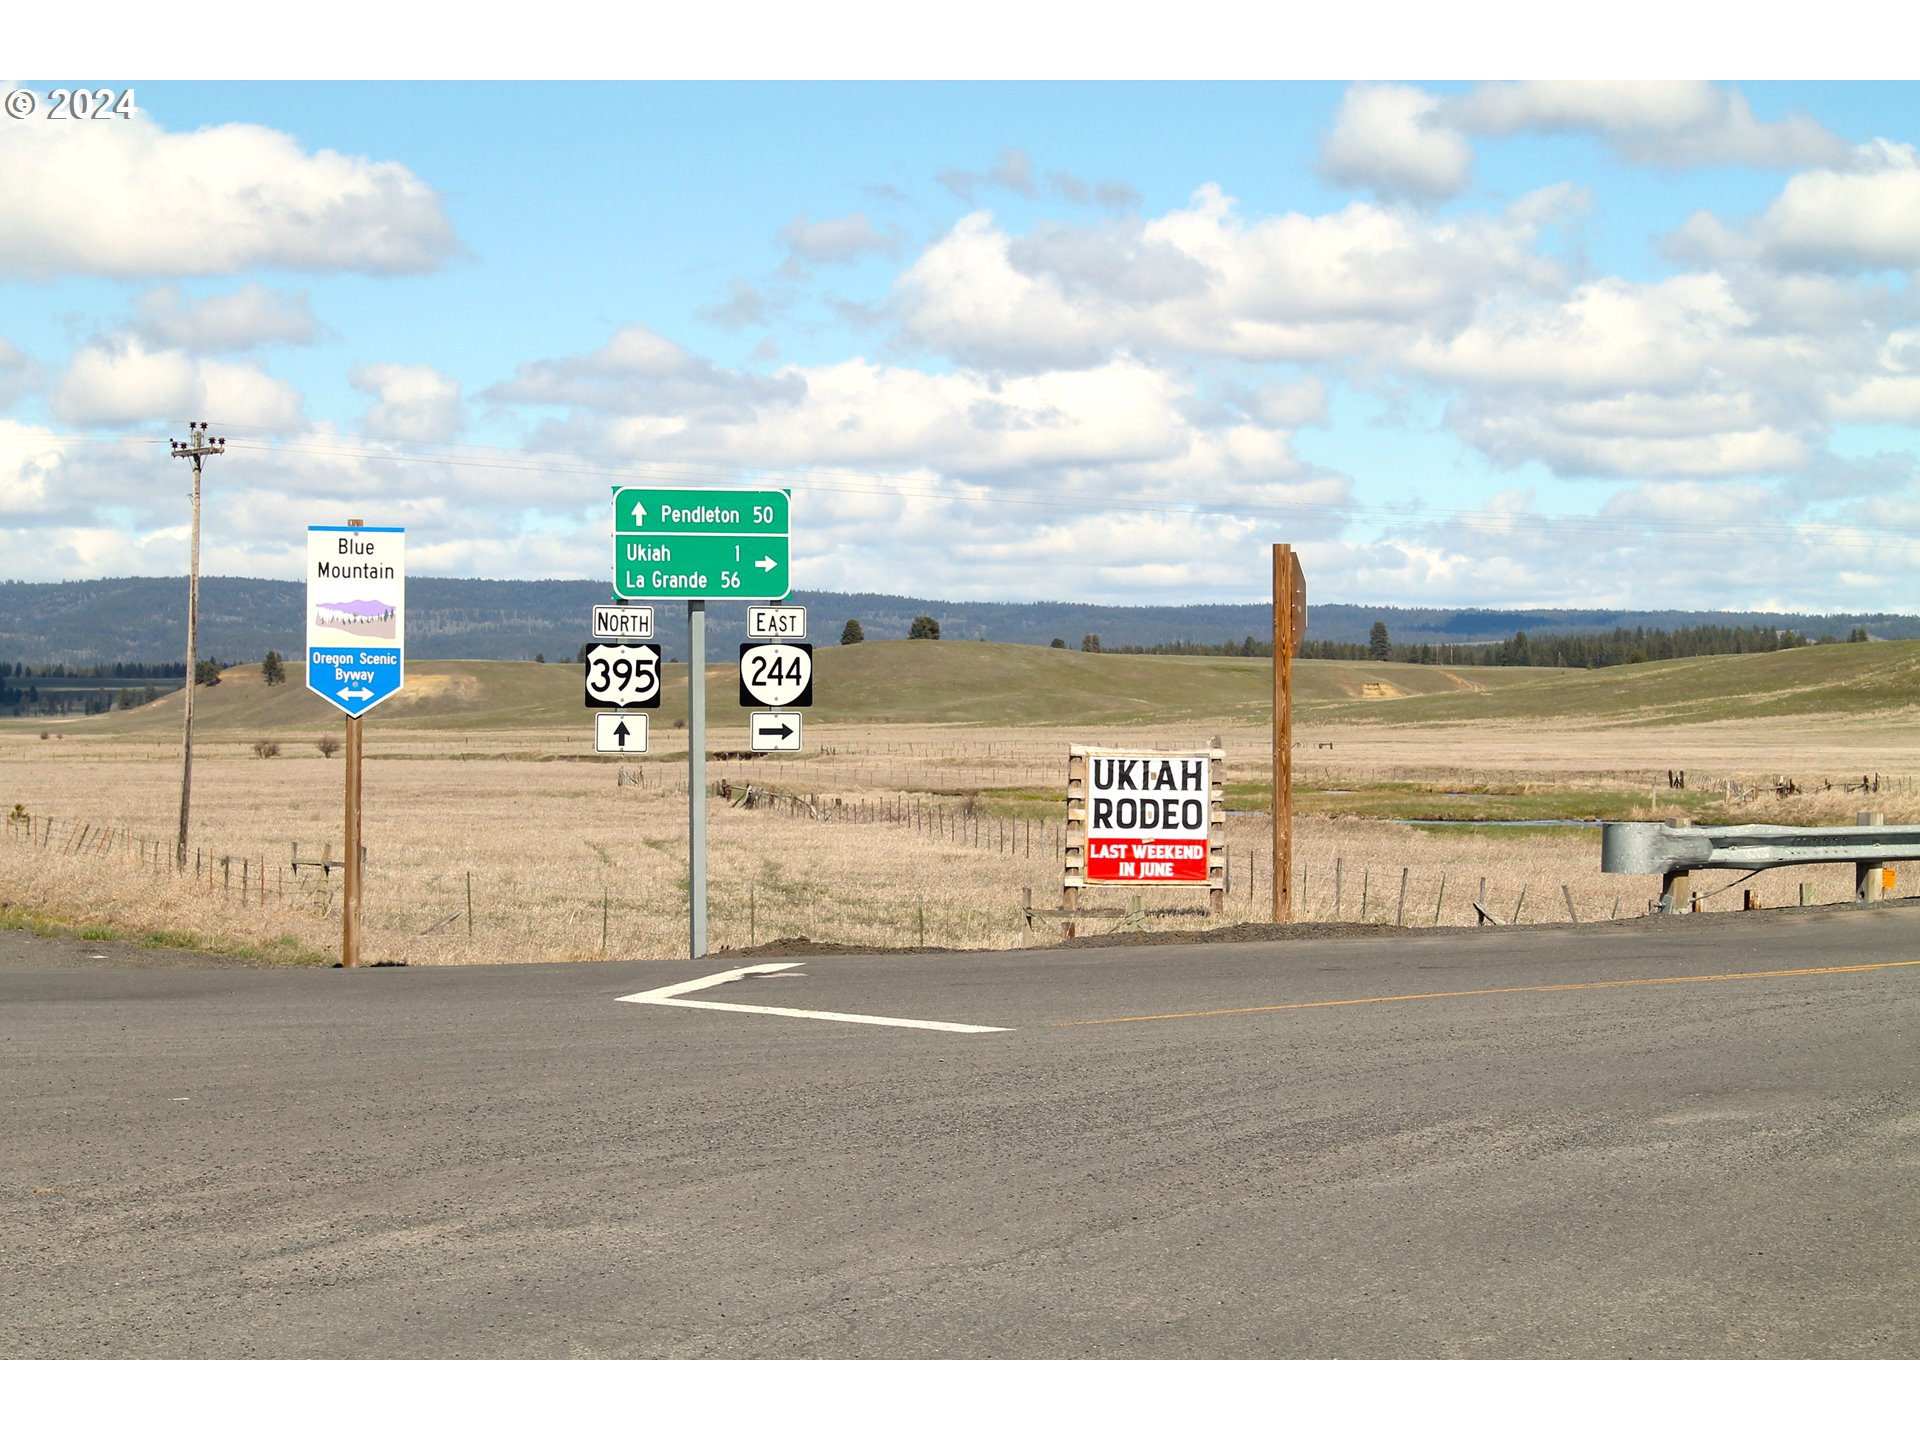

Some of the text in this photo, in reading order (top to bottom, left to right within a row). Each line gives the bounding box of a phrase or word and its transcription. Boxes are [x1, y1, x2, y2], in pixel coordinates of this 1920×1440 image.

[661, 505, 773, 524] Pendleton 50
[338, 538, 375, 555] Blue
[626, 543, 740, 562] Ukiah 1
[318, 561, 394, 579] Mountain
[626, 570, 741, 589] La Grande 56
[598, 612, 649, 632] NORTH
[756, 612, 797, 632] EAST
[312, 651, 397, 668] Oregon Scenic
[335, 667, 375, 683] Byway
[590, 658, 655, 693] 395
[751, 656, 802, 686] 244
[1093, 759, 1203, 791] UKIAH
[1092, 798, 1203, 830] RODEO
[1090, 844, 1204, 860] LAST WEEKEND
[1119, 862, 1174, 879] IN JUNE
